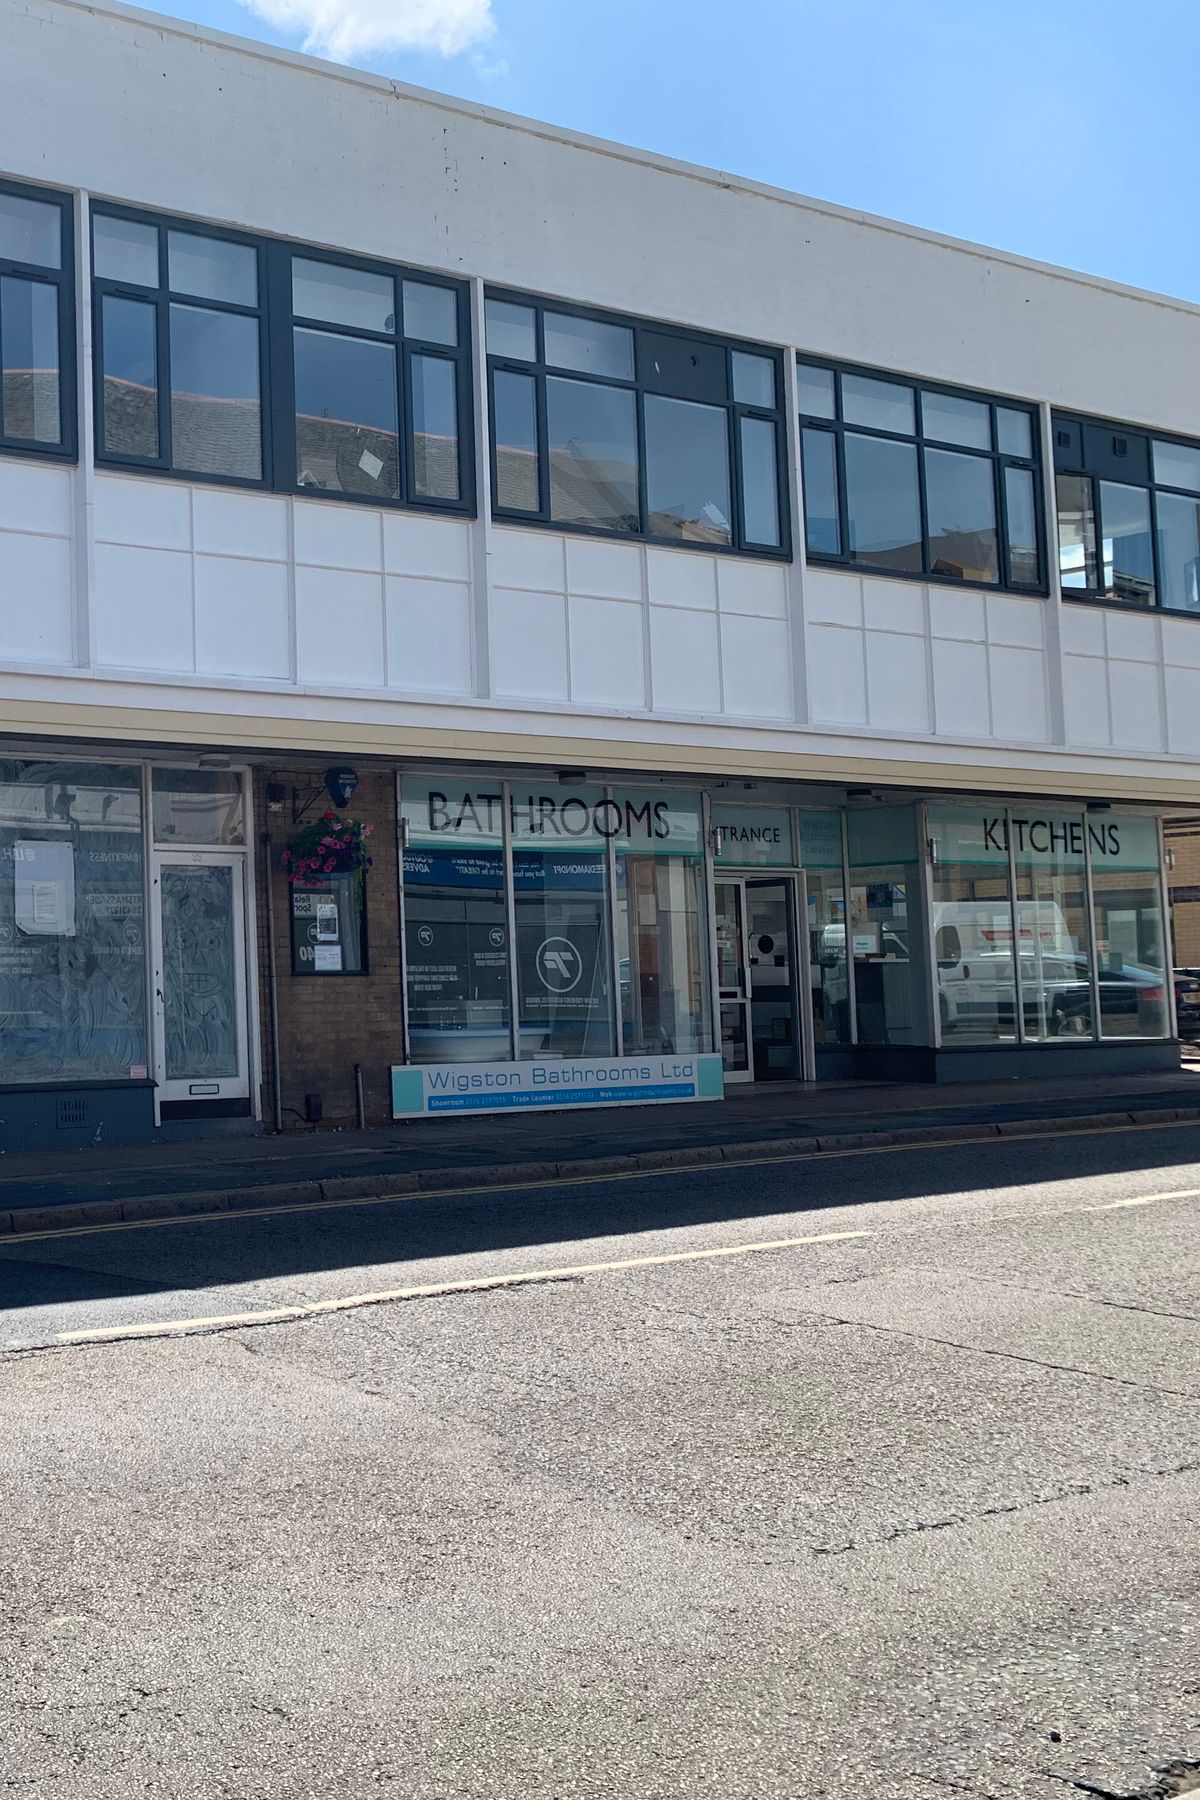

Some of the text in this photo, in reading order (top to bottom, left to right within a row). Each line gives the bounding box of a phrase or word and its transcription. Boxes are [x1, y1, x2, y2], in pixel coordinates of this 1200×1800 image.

[428, 791, 670, 839] BATHROOMS
[712, 826, 780, 843] TRANCE
[983, 818, 1121, 856] KITCHENS
[428, 1062, 693, 1092] Wigston Bathrooms Ltd
[431, 1099, 464, 1107] Showroom
[512, 1095, 529, 1103] Trade
[531, 1094, 554, 1103] Counter
